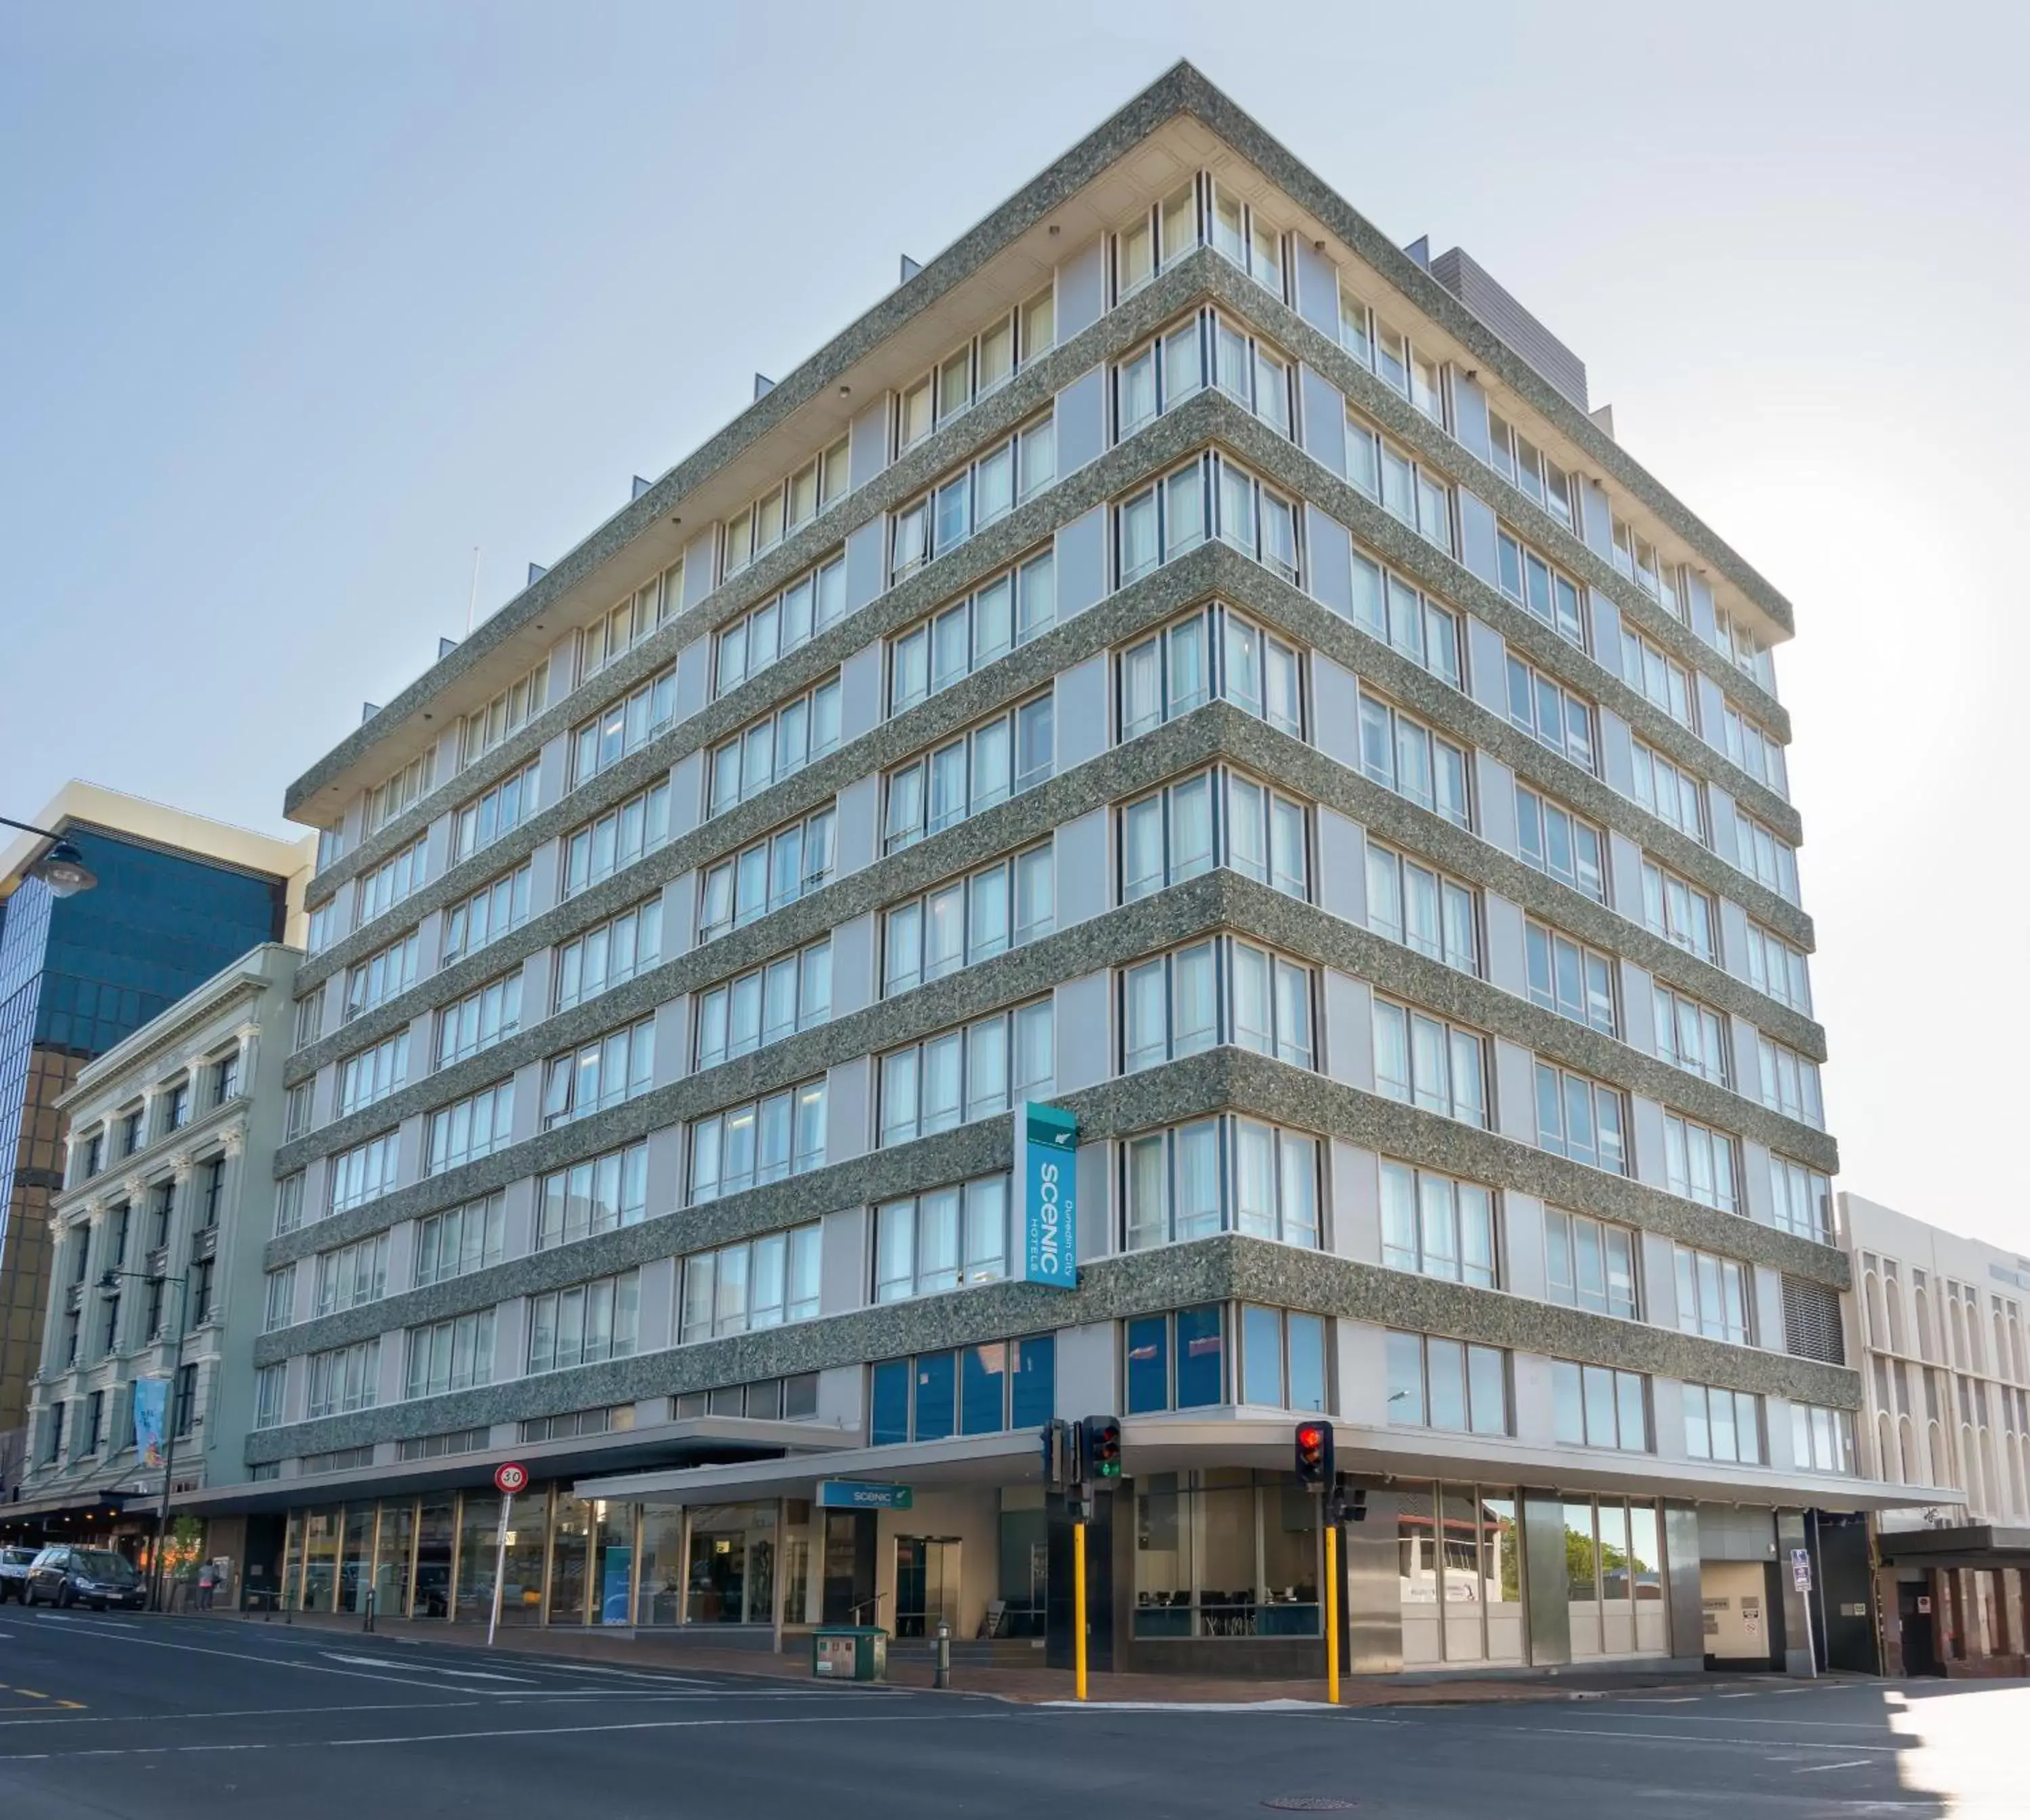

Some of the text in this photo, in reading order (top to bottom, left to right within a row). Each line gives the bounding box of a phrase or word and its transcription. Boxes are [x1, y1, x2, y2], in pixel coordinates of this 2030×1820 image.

[1030, 1219, 1038, 1271] HOTELS
[1064, 1200, 1073, 1277] Dunedin City
[503, 1470, 520, 1482] 30
